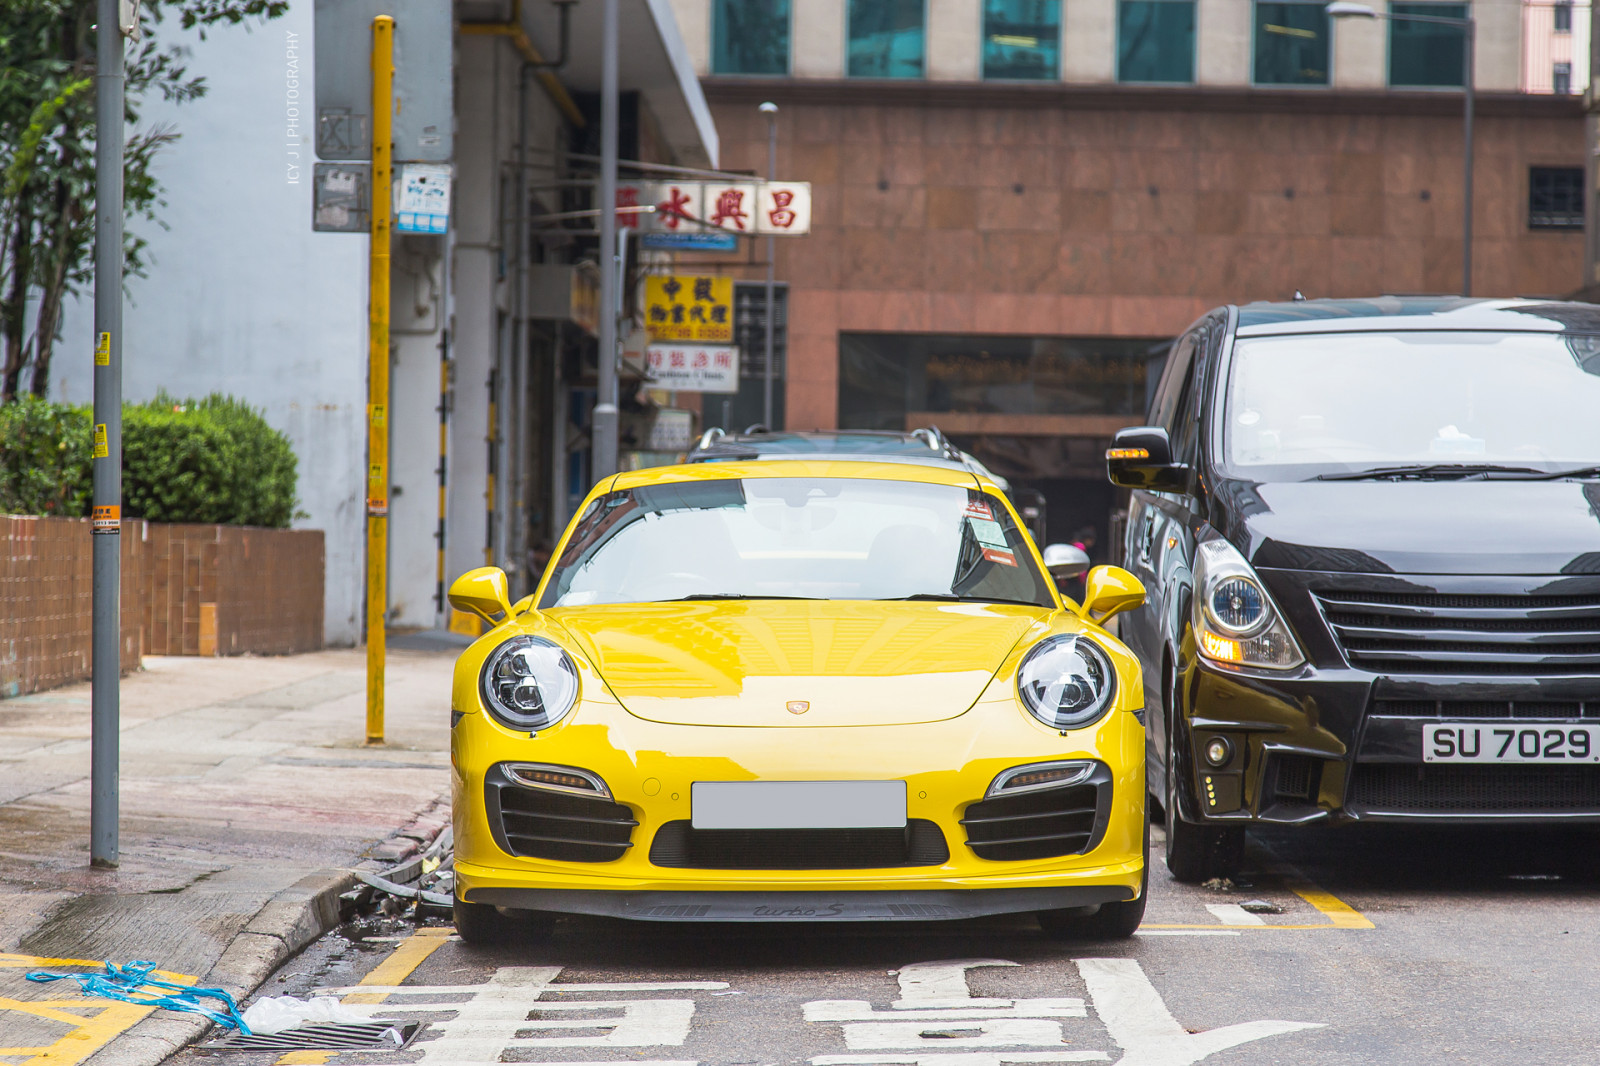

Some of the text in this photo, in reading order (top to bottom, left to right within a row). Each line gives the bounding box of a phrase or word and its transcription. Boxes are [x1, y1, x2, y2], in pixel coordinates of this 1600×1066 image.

[1433, 729, 1591, 759] SU 7029
[753, 904, 845, 917] turbo S
